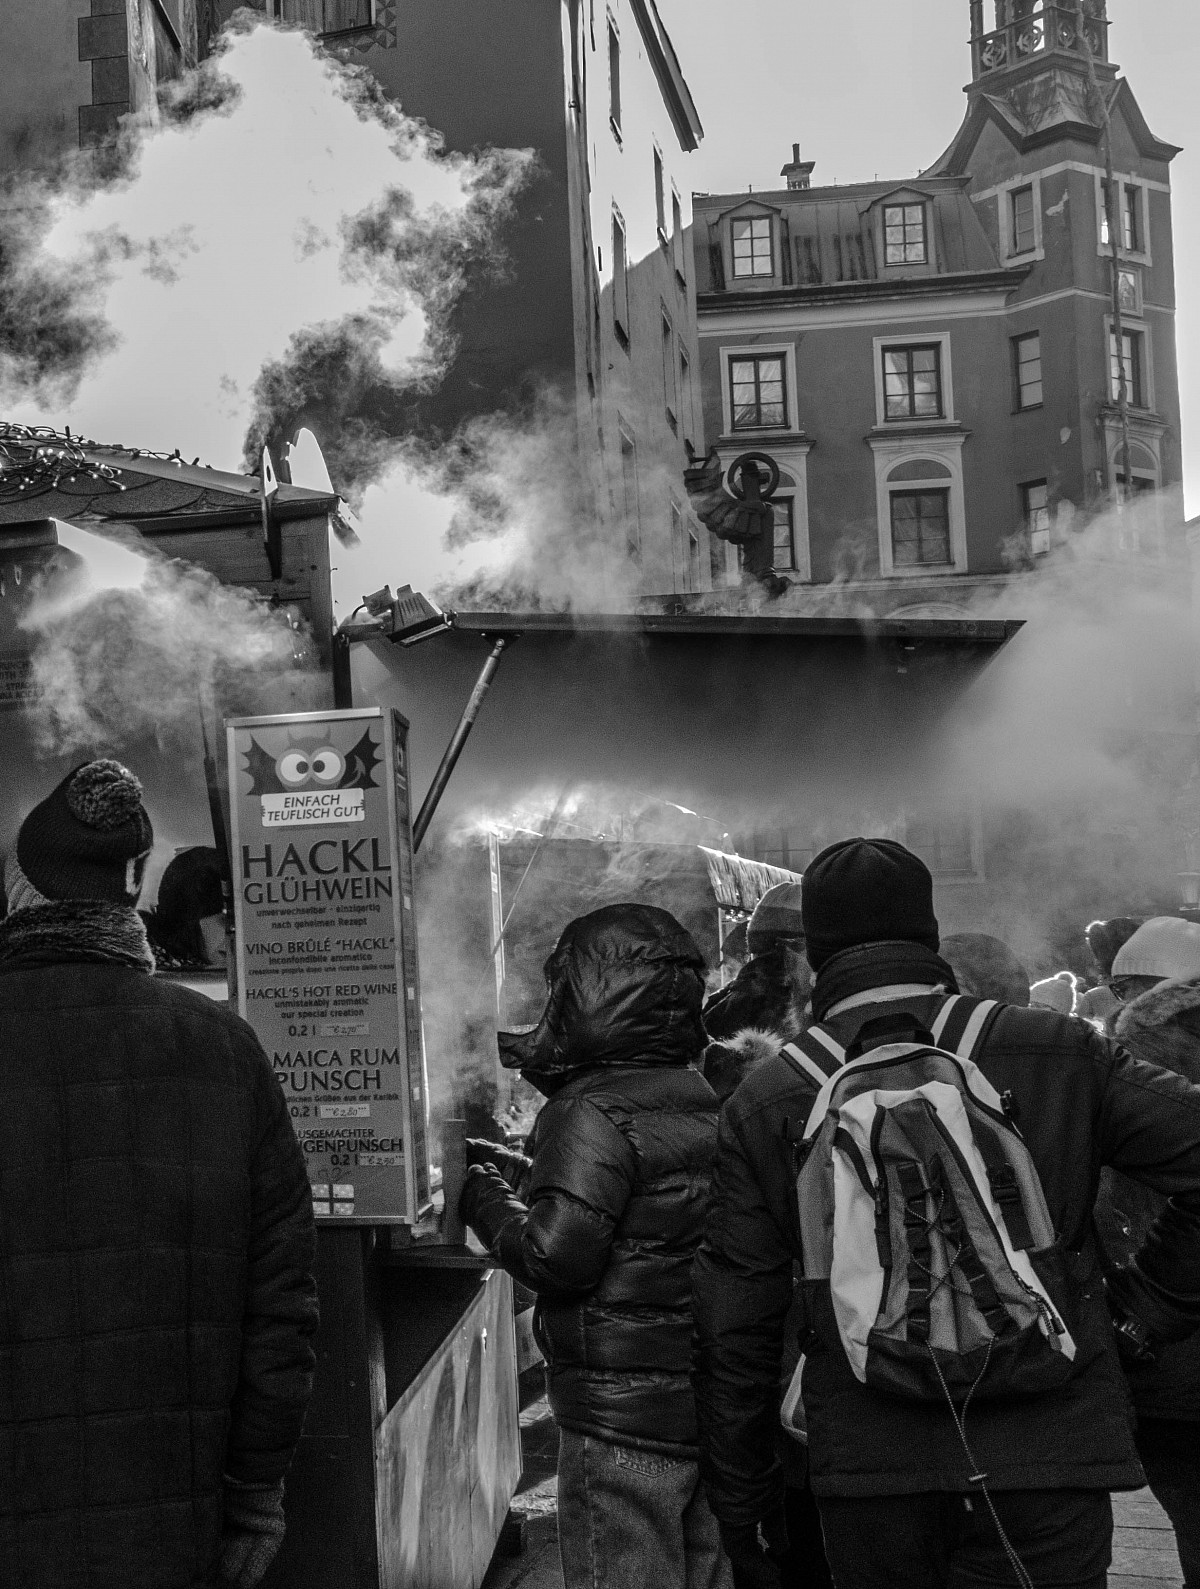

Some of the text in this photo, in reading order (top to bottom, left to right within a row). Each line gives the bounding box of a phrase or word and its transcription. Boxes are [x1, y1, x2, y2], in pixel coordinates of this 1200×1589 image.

[284, 794, 341, 809] EINFACH
[267, 805, 360, 822] TEUFLISCH GUT
[242, 837, 392, 879] HACKL
[244, 875, 393, 905] GLÜHWEIN
[271, 920, 292, 929] nach
[338, 917, 368, 928] Rezept
[246, 942, 283, 955] VINO
[246, 983, 397, 1000] HACKL'S HOT RED WINE
[281, 1007, 365, 1019] our special creation
[273, 1048, 400, 1069] MAICA RUM
[298, 1128, 375, 1139] USGEMACHTER
[301, 1138, 402, 1153] GENPUNSCH
